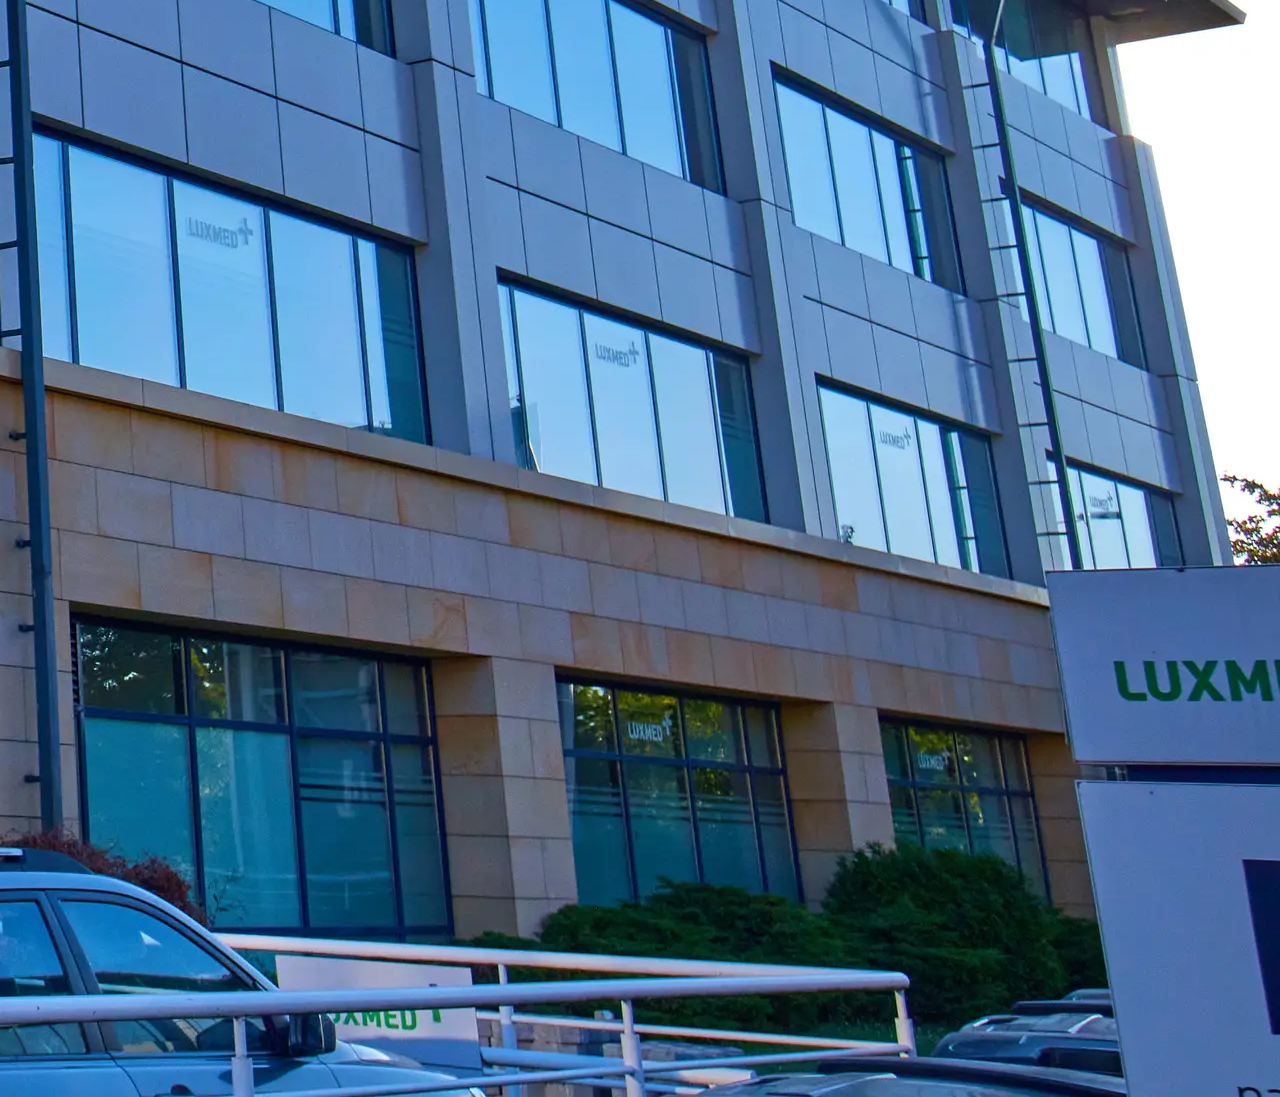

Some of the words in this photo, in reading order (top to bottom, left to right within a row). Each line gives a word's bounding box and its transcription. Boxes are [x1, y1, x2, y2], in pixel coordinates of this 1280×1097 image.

[186, 216, 239, 249] LUXMED
[594, 342, 630, 368] LUXMED
[1113, 659, 1280, 701] LUXM
[627, 721, 663, 741] LUXMED
